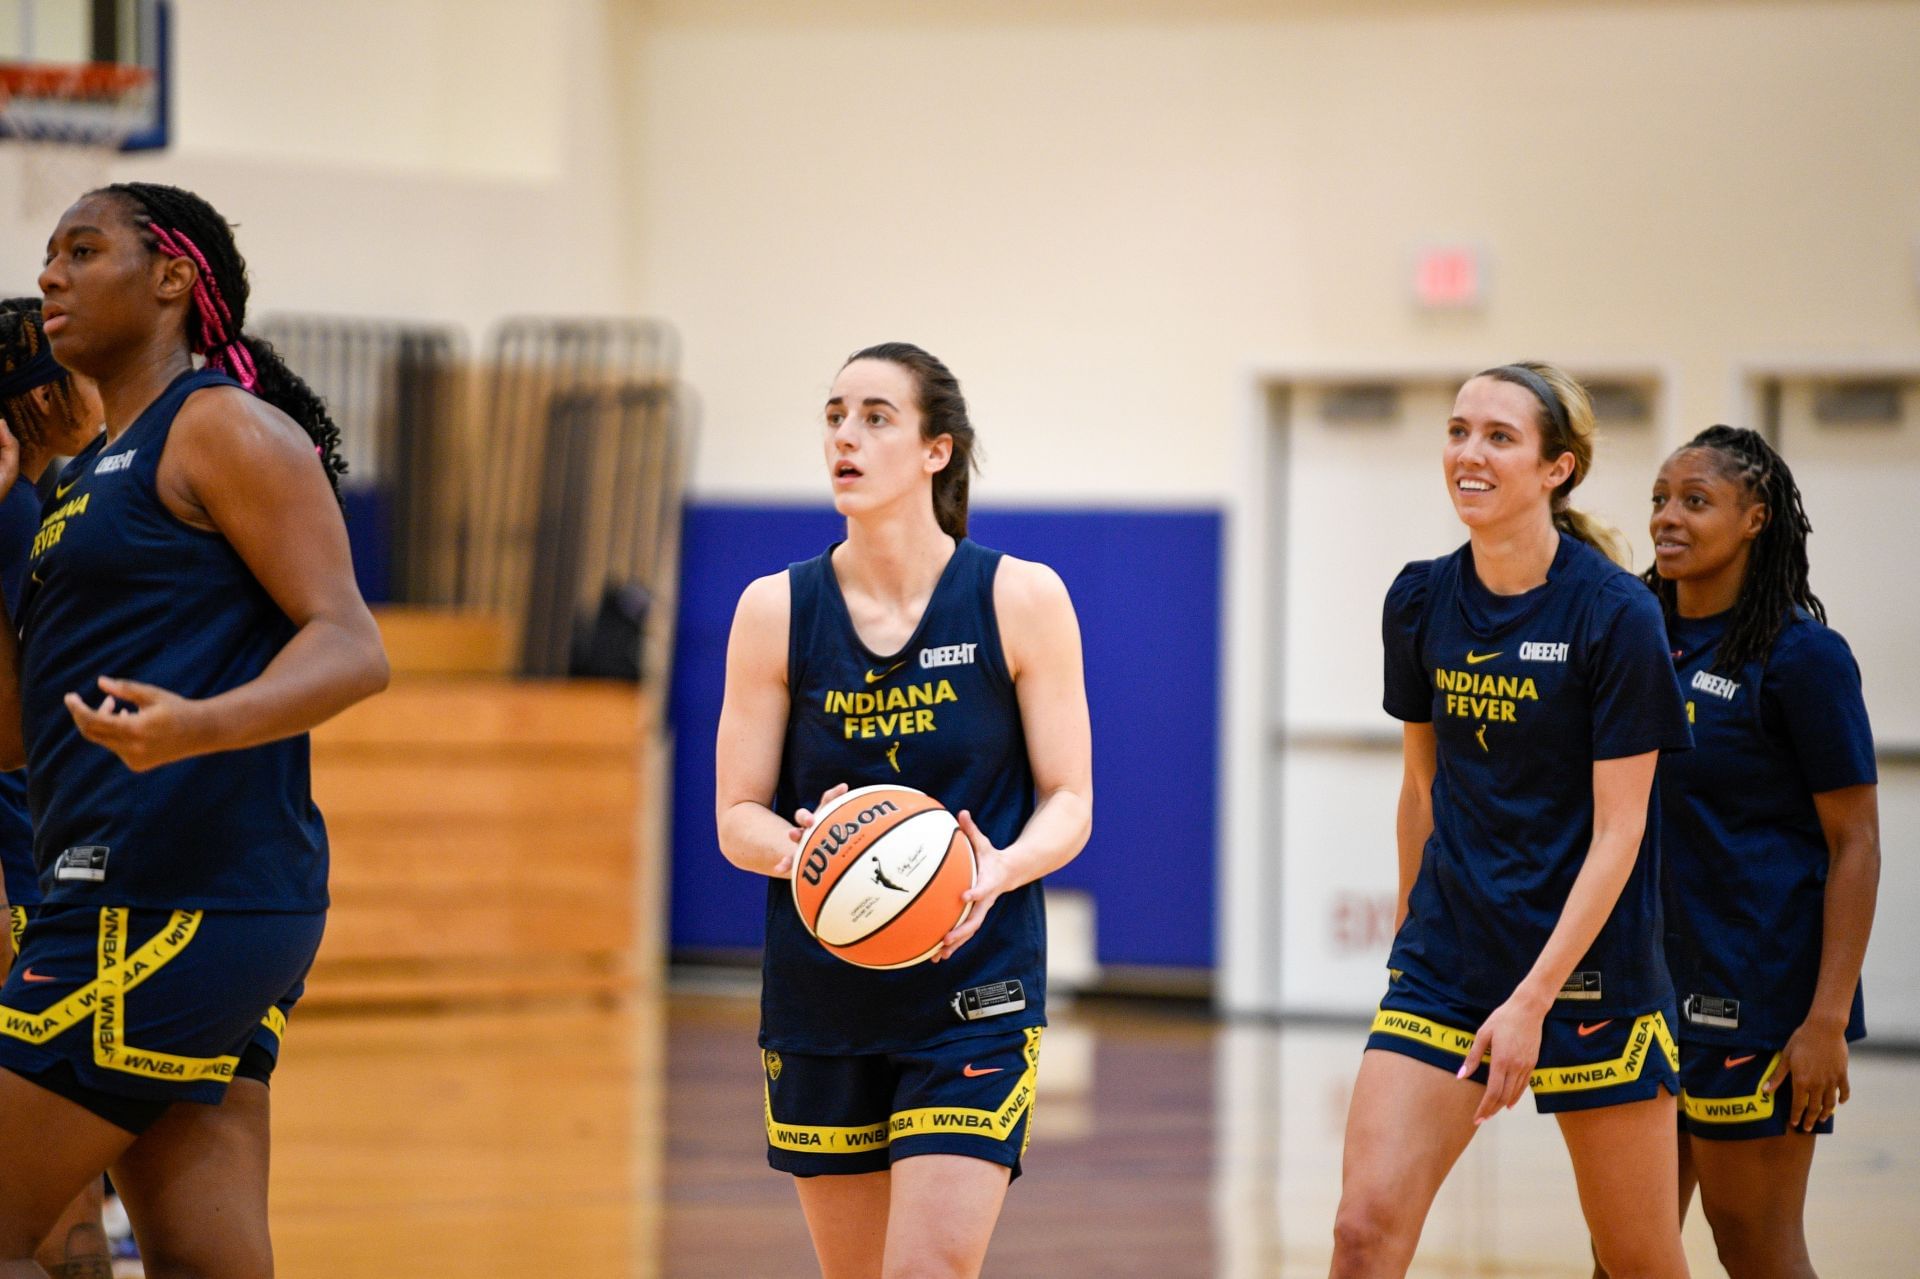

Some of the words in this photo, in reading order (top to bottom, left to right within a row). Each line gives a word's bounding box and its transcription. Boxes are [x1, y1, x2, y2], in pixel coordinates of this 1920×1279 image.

[824, 679, 958, 714] INDIANA
[1436, 668, 1539, 700] INDIANA
[1447, 694, 1517, 722] FEVER
[844, 709, 937, 739] FEVER
[801, 800, 899, 887] Wilson
[103, 907, 119, 969] WNBA
[165, 909, 194, 946] WN
[1384, 1017, 1433, 1038] WNBA
[124, 1055, 185, 1076] WNBA
[1560, 1067, 1617, 1084] WNBA
[933, 1114, 993, 1129] WNBA
[998, 1086, 1030, 1128] WNBA
[1705, 1101, 1757, 1116] WNBA
[777, 1130, 822, 1146] WNBA
